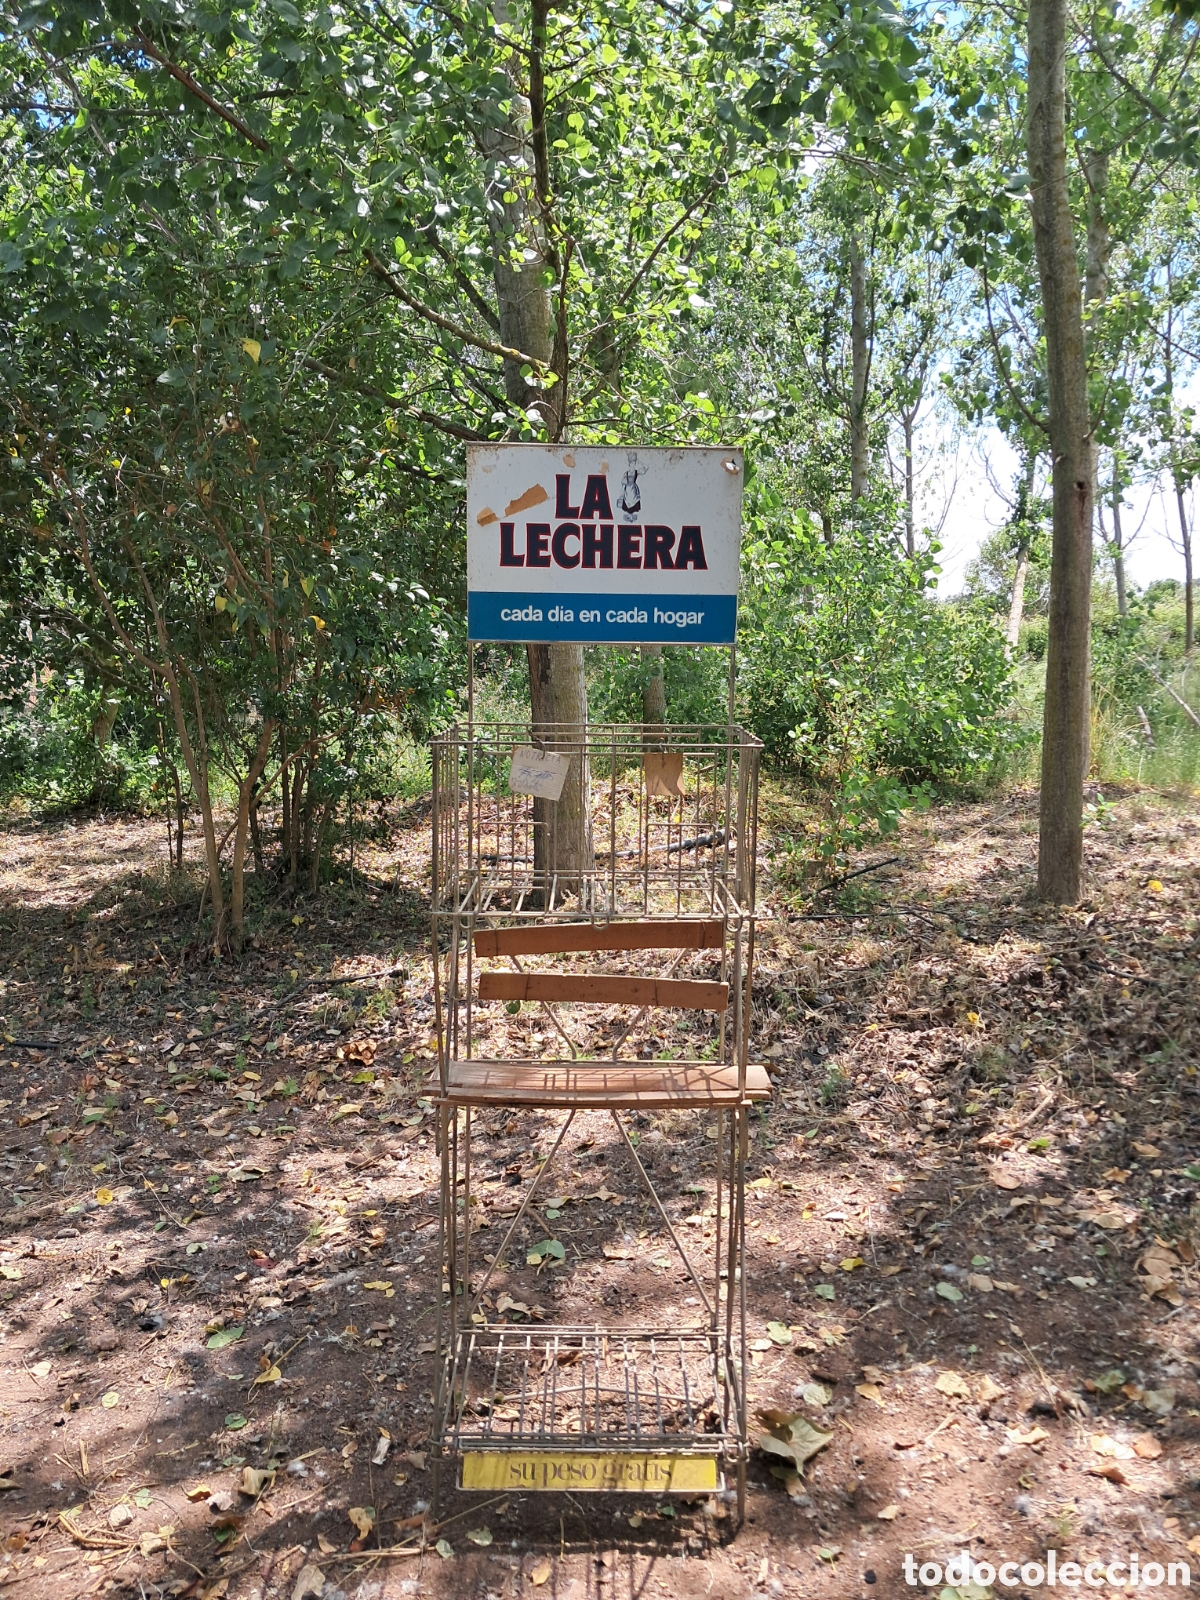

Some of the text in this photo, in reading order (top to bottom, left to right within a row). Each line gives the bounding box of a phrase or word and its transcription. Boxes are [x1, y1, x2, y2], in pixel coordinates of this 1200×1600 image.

[555, 474, 614, 520] LA
[499, 522, 709, 570] LECHERA
[500, 605, 543, 623] cada
[579, 610, 601, 624] en
[605, 607, 648, 624] cada
[653, 607, 705, 627] hogar
[510, 1461, 535, 1480] su
[542, 1461, 597, 1487] peso
